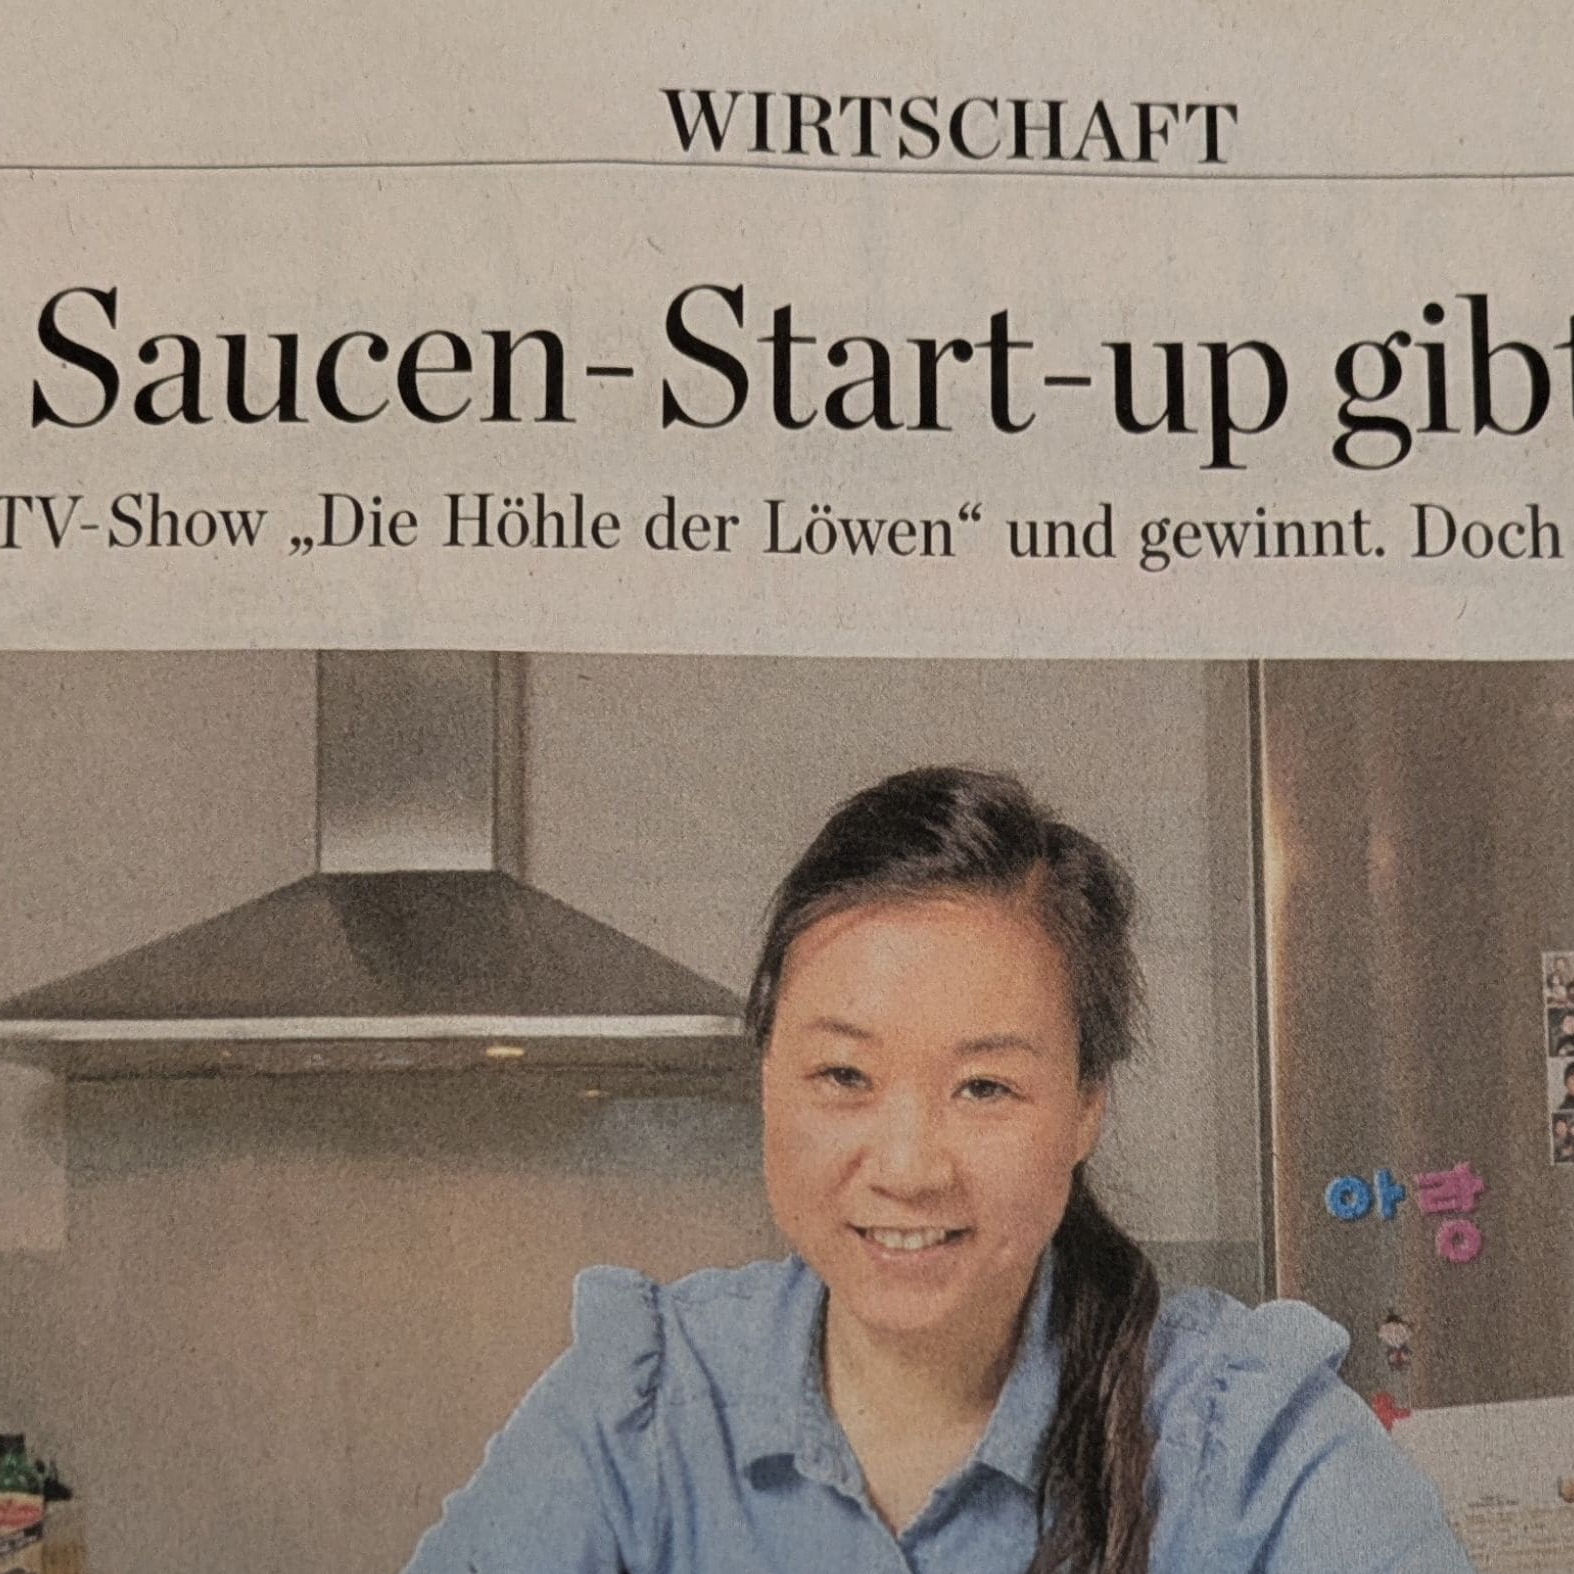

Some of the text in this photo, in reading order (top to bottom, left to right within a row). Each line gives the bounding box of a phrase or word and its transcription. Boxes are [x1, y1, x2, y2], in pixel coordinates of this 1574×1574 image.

[660, 88, 1238, 164] WIRTSCHAFT
[31, 283, 1289, 470] Saucen-Start-up
[443, 492, 621, 550] Höhle
[644, 494, 740, 552] der
[1006, 502, 1116, 558] und
[1139, 506, 1385, 573] gewinnt.
[1412, 503, 1563, 559] Doch
